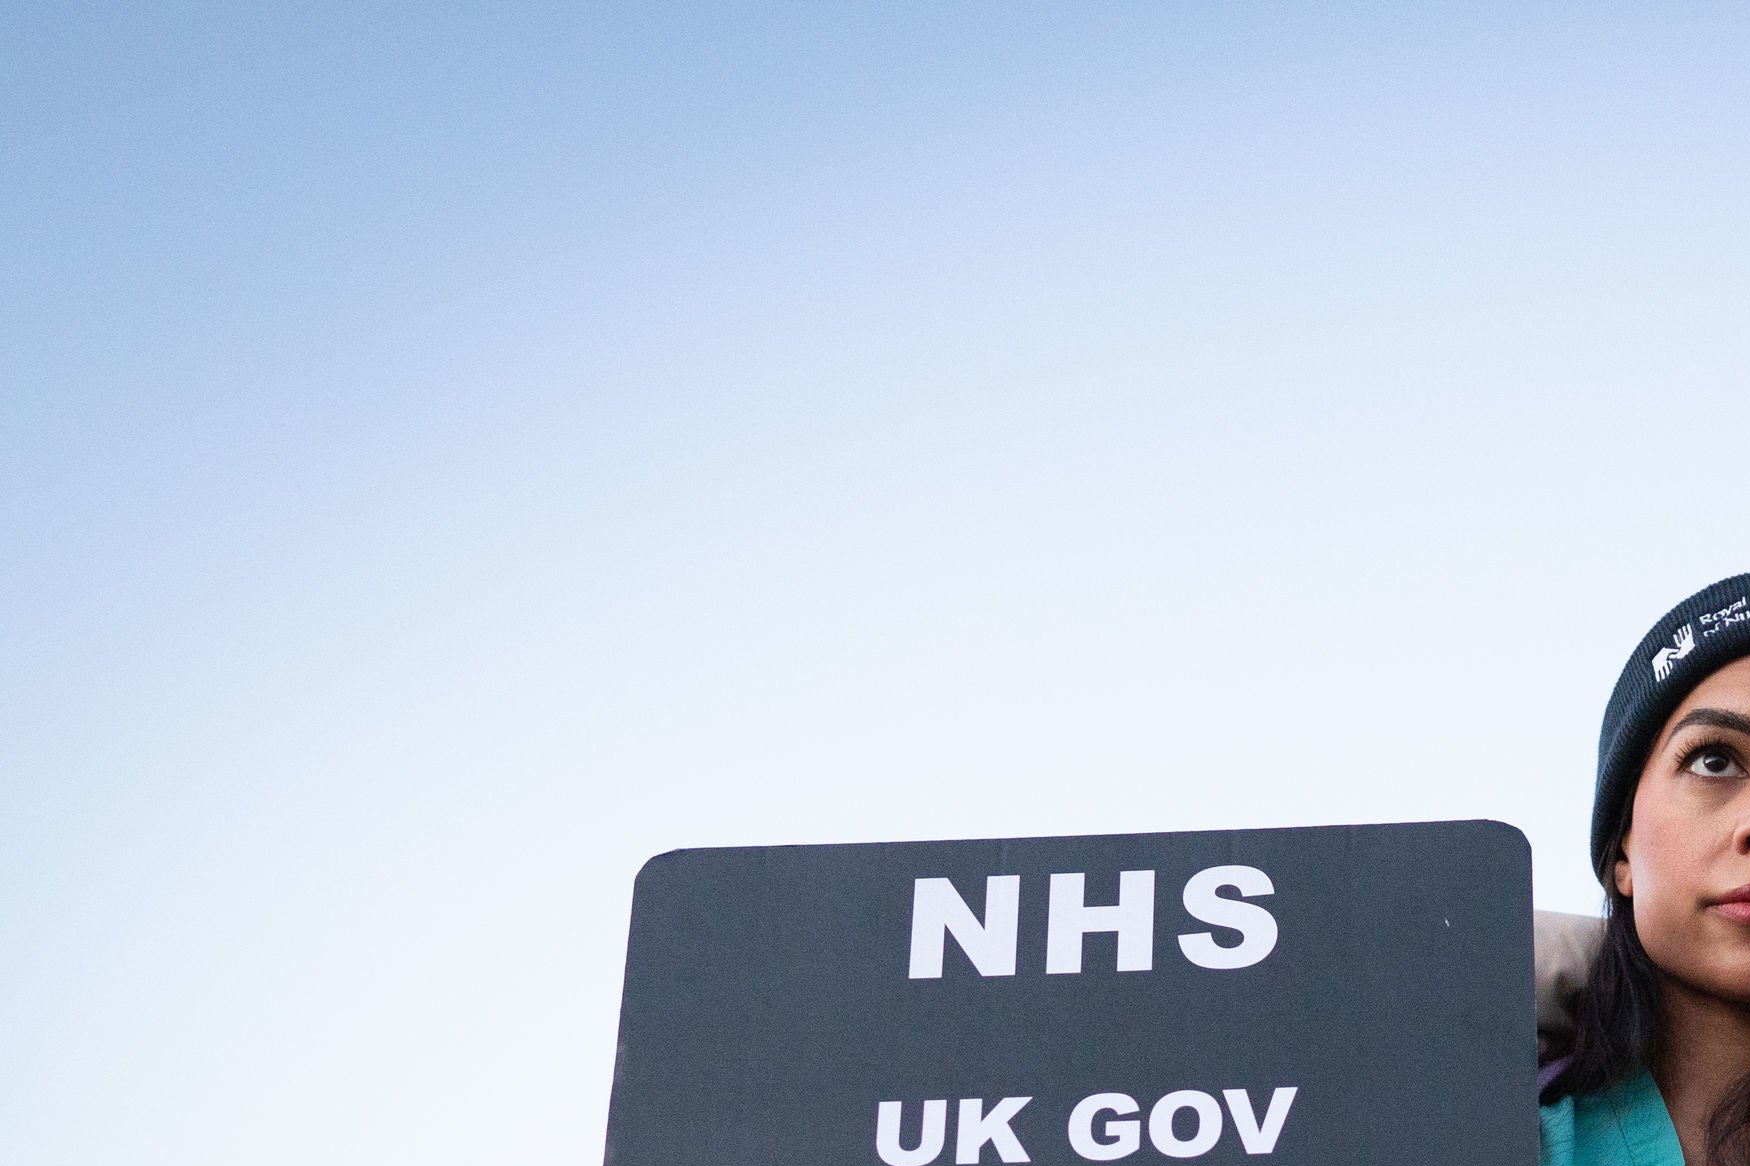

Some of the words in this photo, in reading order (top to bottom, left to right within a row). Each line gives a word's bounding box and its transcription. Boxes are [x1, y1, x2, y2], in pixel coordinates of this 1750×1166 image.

[1700, 597, 1746, 625] Royal
[908, 865, 1279, 980] NHS
[1068, 1086, 1299, 1162] GOV
